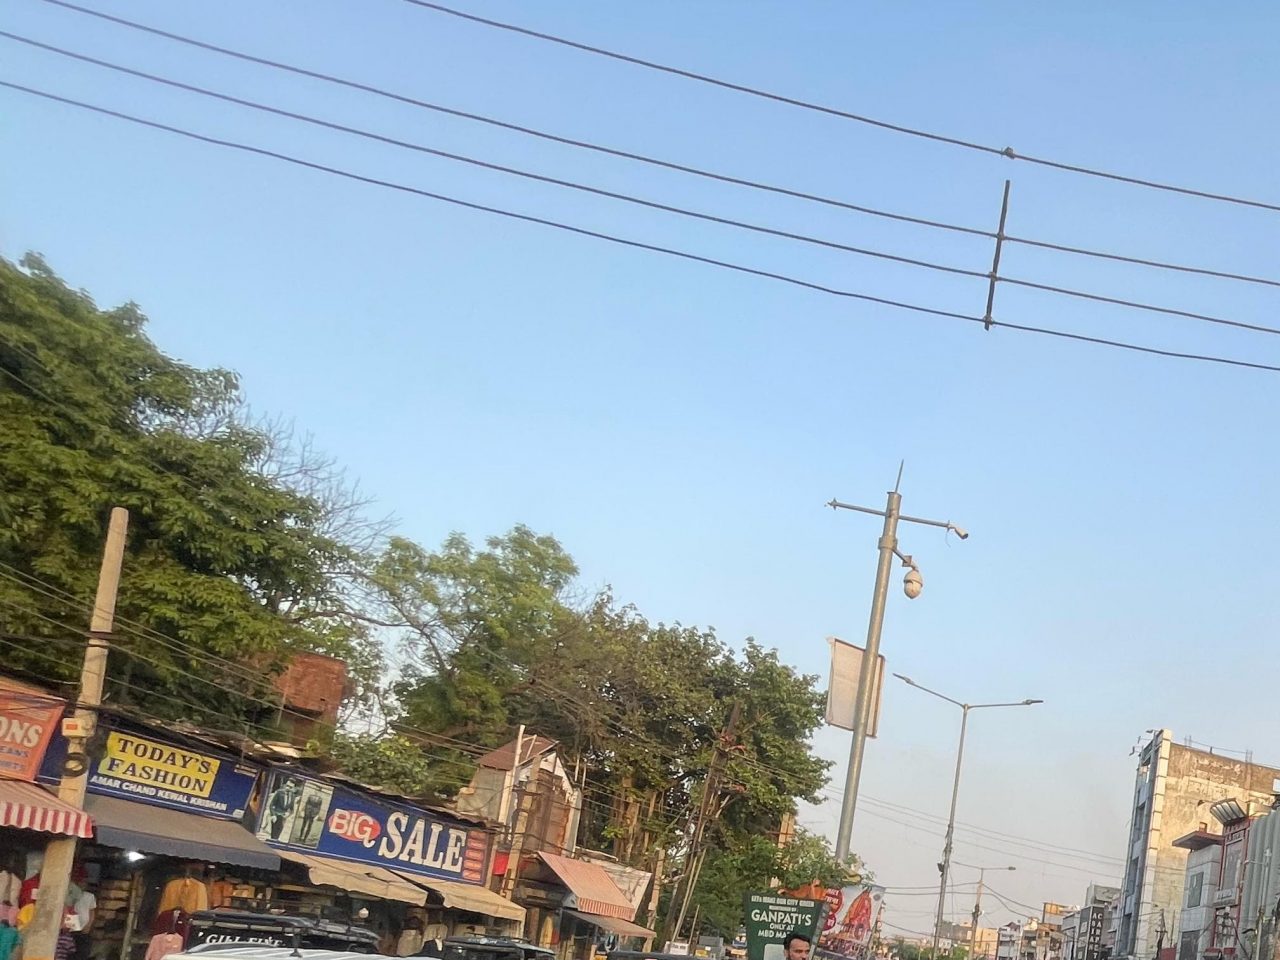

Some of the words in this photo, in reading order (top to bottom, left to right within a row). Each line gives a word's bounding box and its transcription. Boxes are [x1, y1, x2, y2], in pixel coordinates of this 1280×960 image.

[118, 738, 211, 773] TODAY'S
[90, 776, 121, 789] AMAR
[122, 781, 155, 796] CHAND
[157, 788, 188, 803] KEWAL
[107, 759, 208, 792] FASHION
[329, 808, 374, 848] BIG
[378, 811, 467, 873] SALE
[751, 909, 812, 926] GANPATI'S
[769, 922, 786, 930] ONLY
